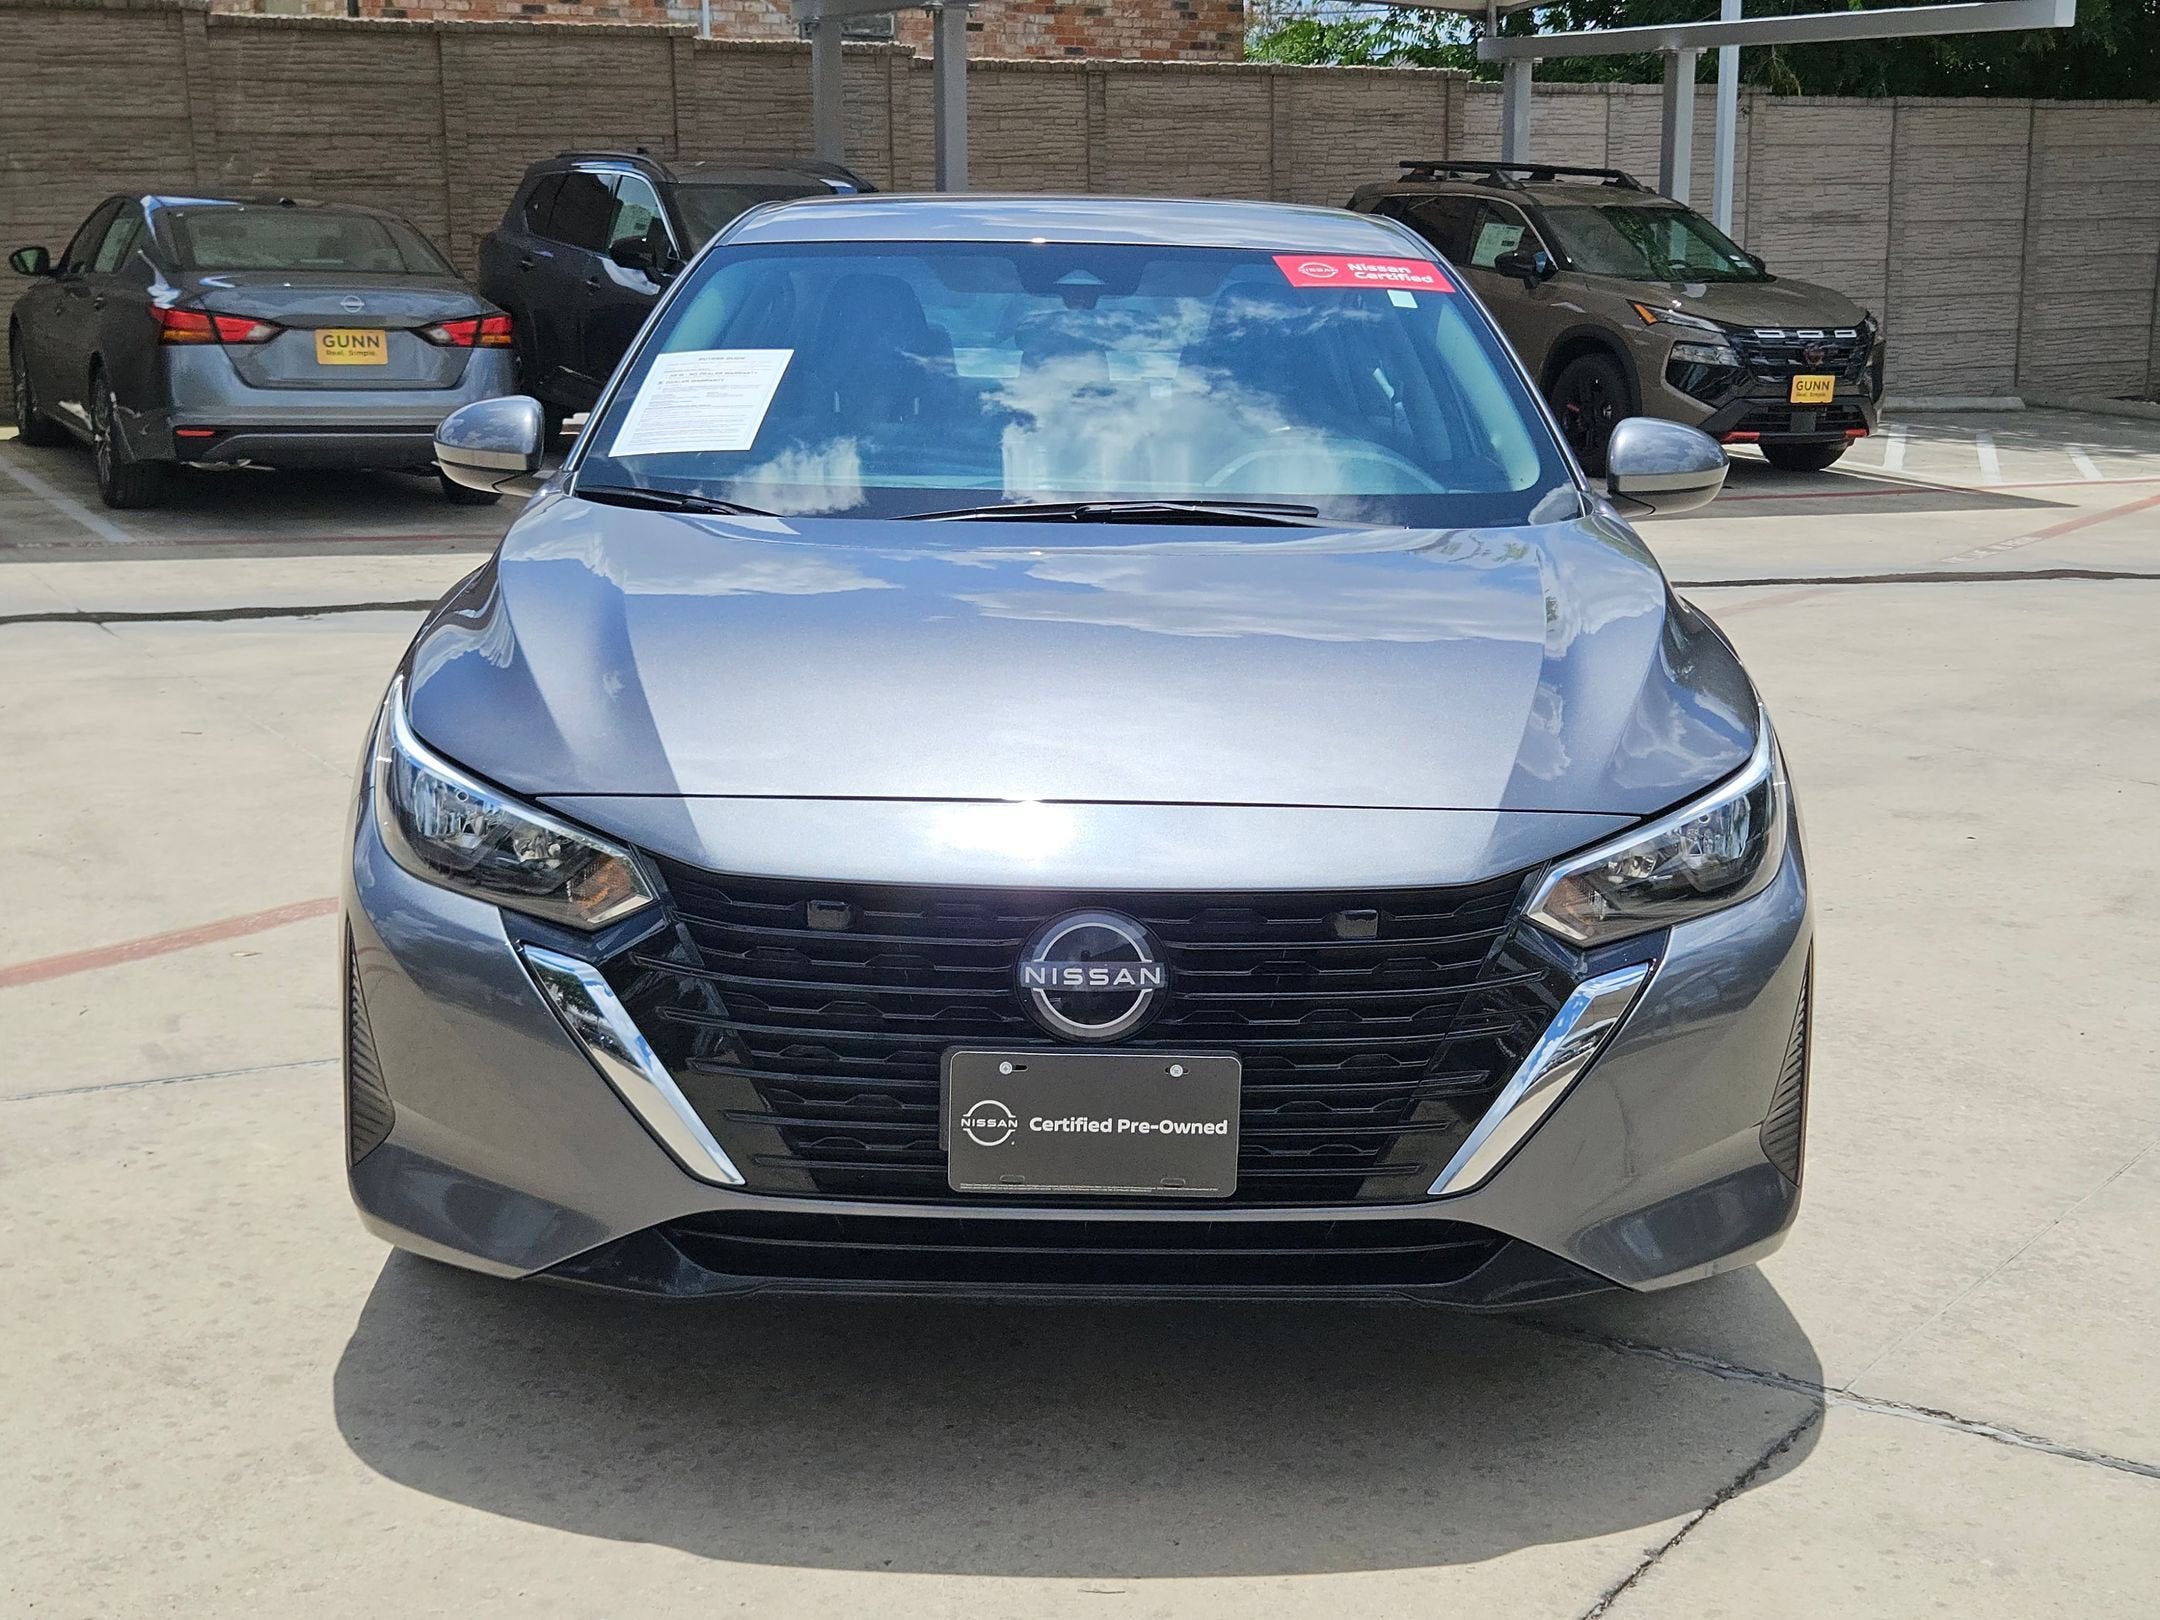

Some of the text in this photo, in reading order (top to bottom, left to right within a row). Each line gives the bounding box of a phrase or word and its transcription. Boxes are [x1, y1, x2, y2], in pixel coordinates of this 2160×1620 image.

[1347, 263, 1412, 274] Nissan
[1354, 272, 1434, 283] Certified
[322, 334, 380, 348] GUNN
[1796, 380, 1830, 391] GUNN
[1024, 966, 1161, 986] NISSAN
[961, 1117, 1228, 1135] NISSAN Certified Pre-Owned
